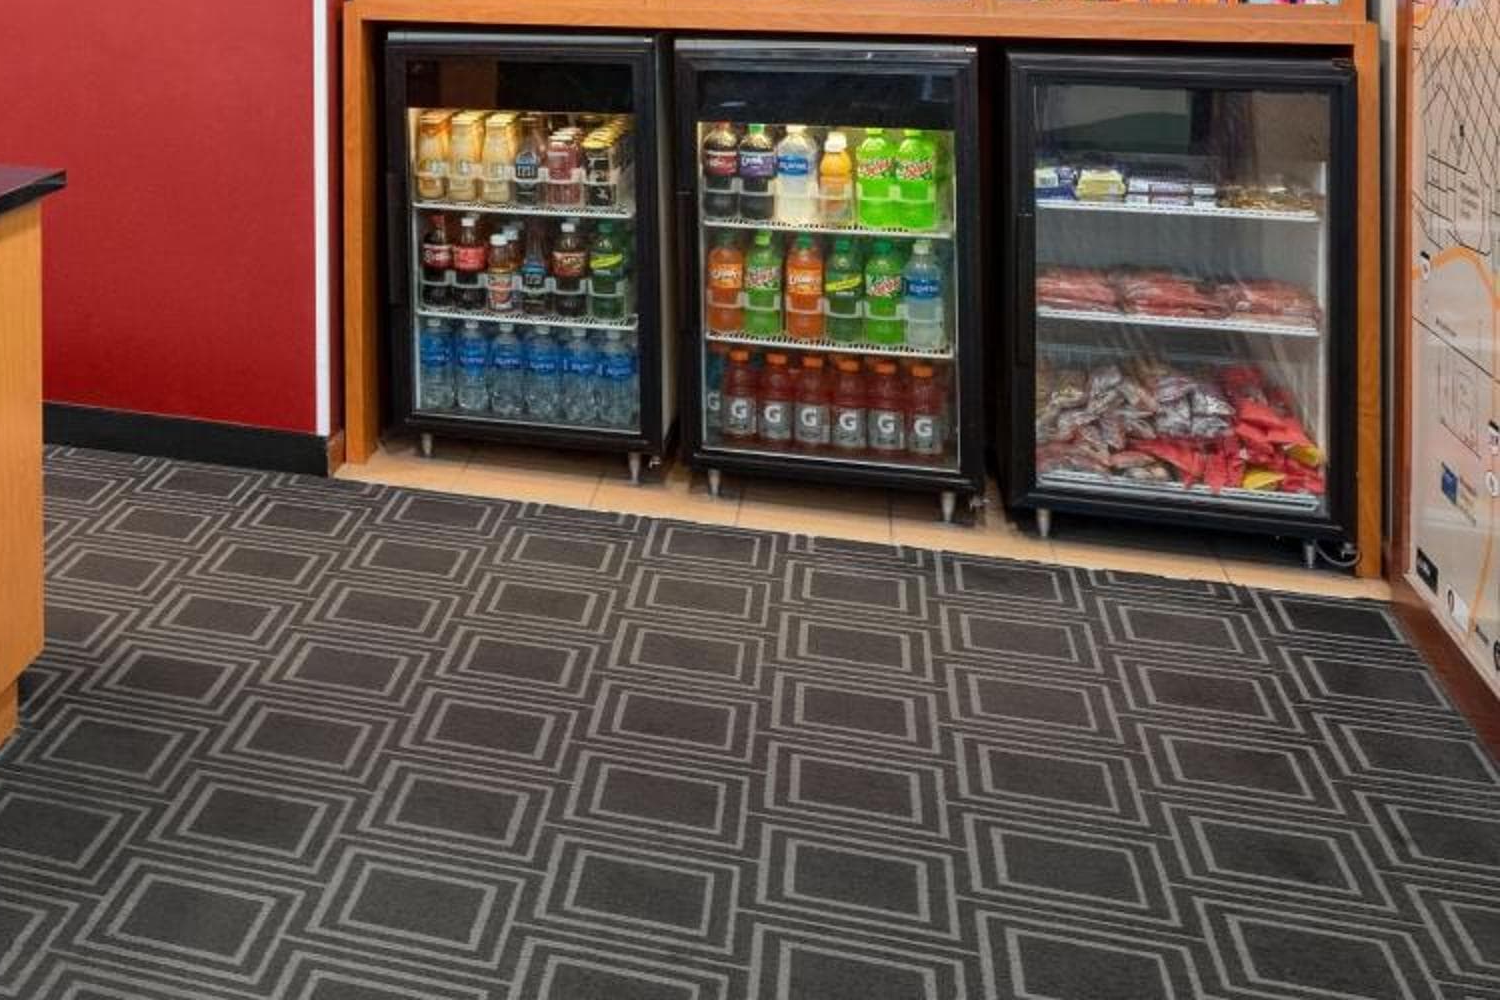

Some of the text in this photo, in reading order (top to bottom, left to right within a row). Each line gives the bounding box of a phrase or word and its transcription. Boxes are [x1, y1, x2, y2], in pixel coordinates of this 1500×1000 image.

[708, 392, 721, 411] G
[731, 400, 748, 419] G
[764, 404, 781, 423] G
[801, 408, 817, 427] G
[839, 412, 857, 431] G
[877, 414, 895, 433] G
[914, 418, 933, 437] G
